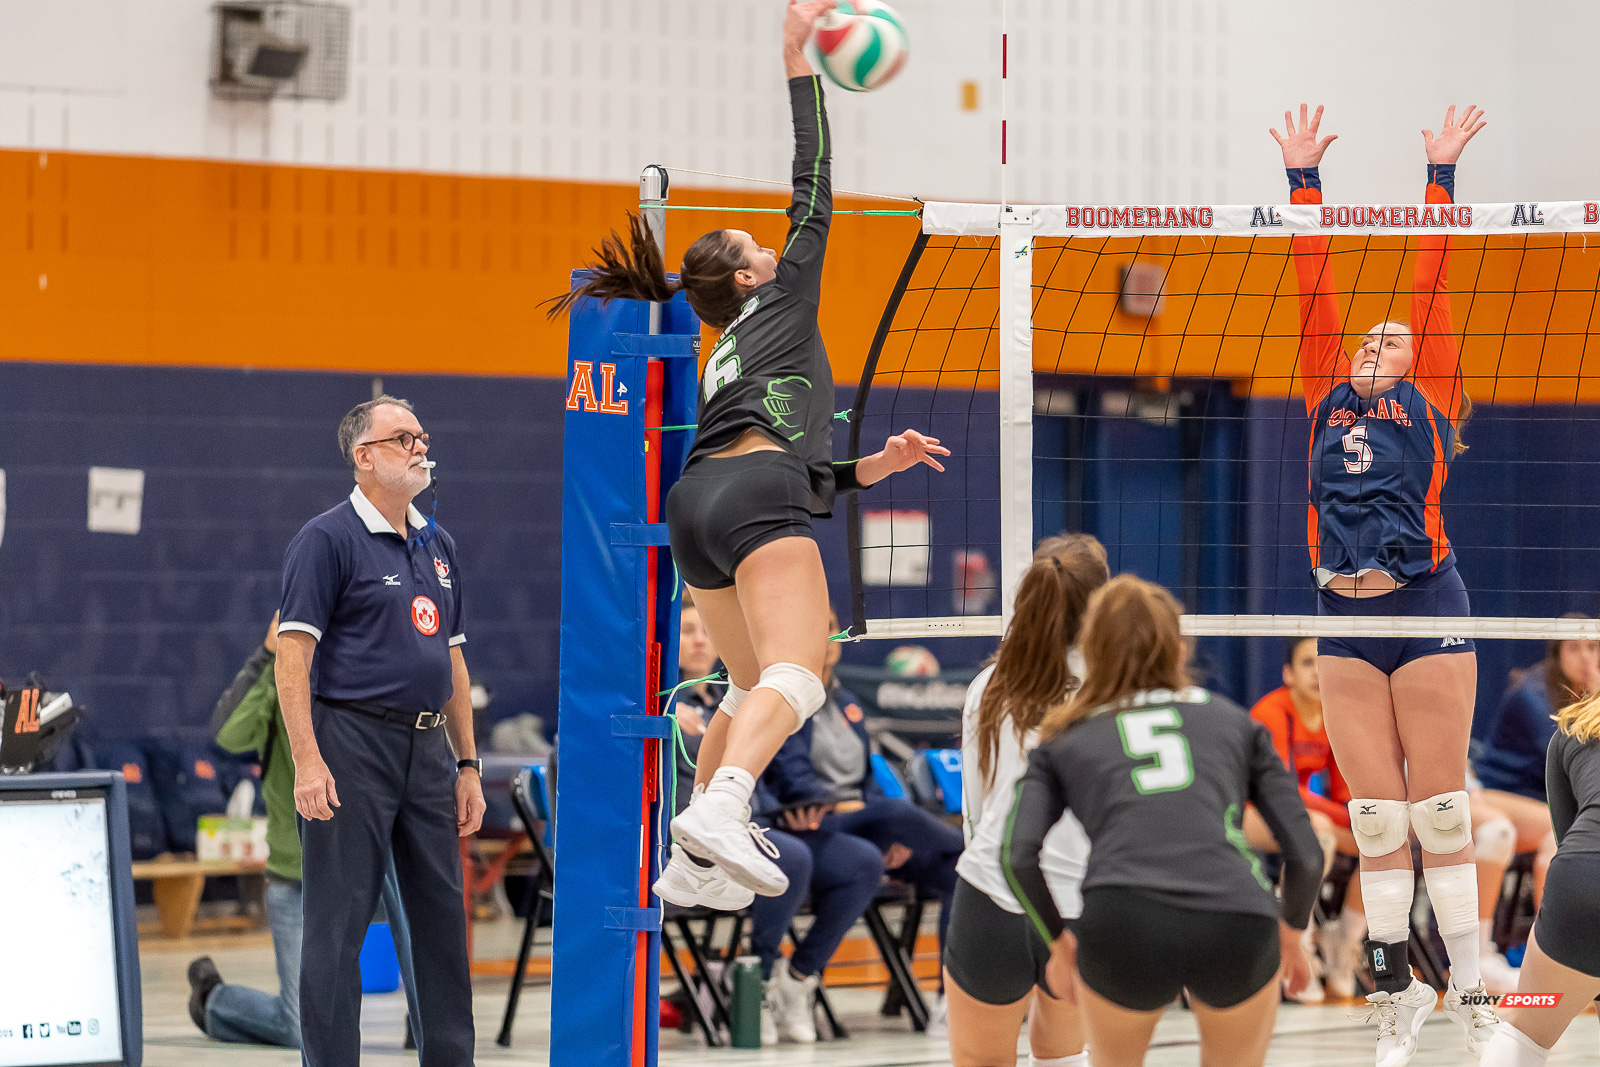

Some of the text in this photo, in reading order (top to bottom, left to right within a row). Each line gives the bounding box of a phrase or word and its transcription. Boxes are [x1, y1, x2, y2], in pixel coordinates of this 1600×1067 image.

[1065, 205, 1213, 228] BOOMERANG
[1250, 206, 1283, 227] AL
[1320, 205, 1472, 228] BOOMERANG
[1511, 203, 1544, 226] AL
[566, 360, 628, 415] AL
[1341, 425, 1373, 475] 5
[1115, 705, 1195, 795] 5
